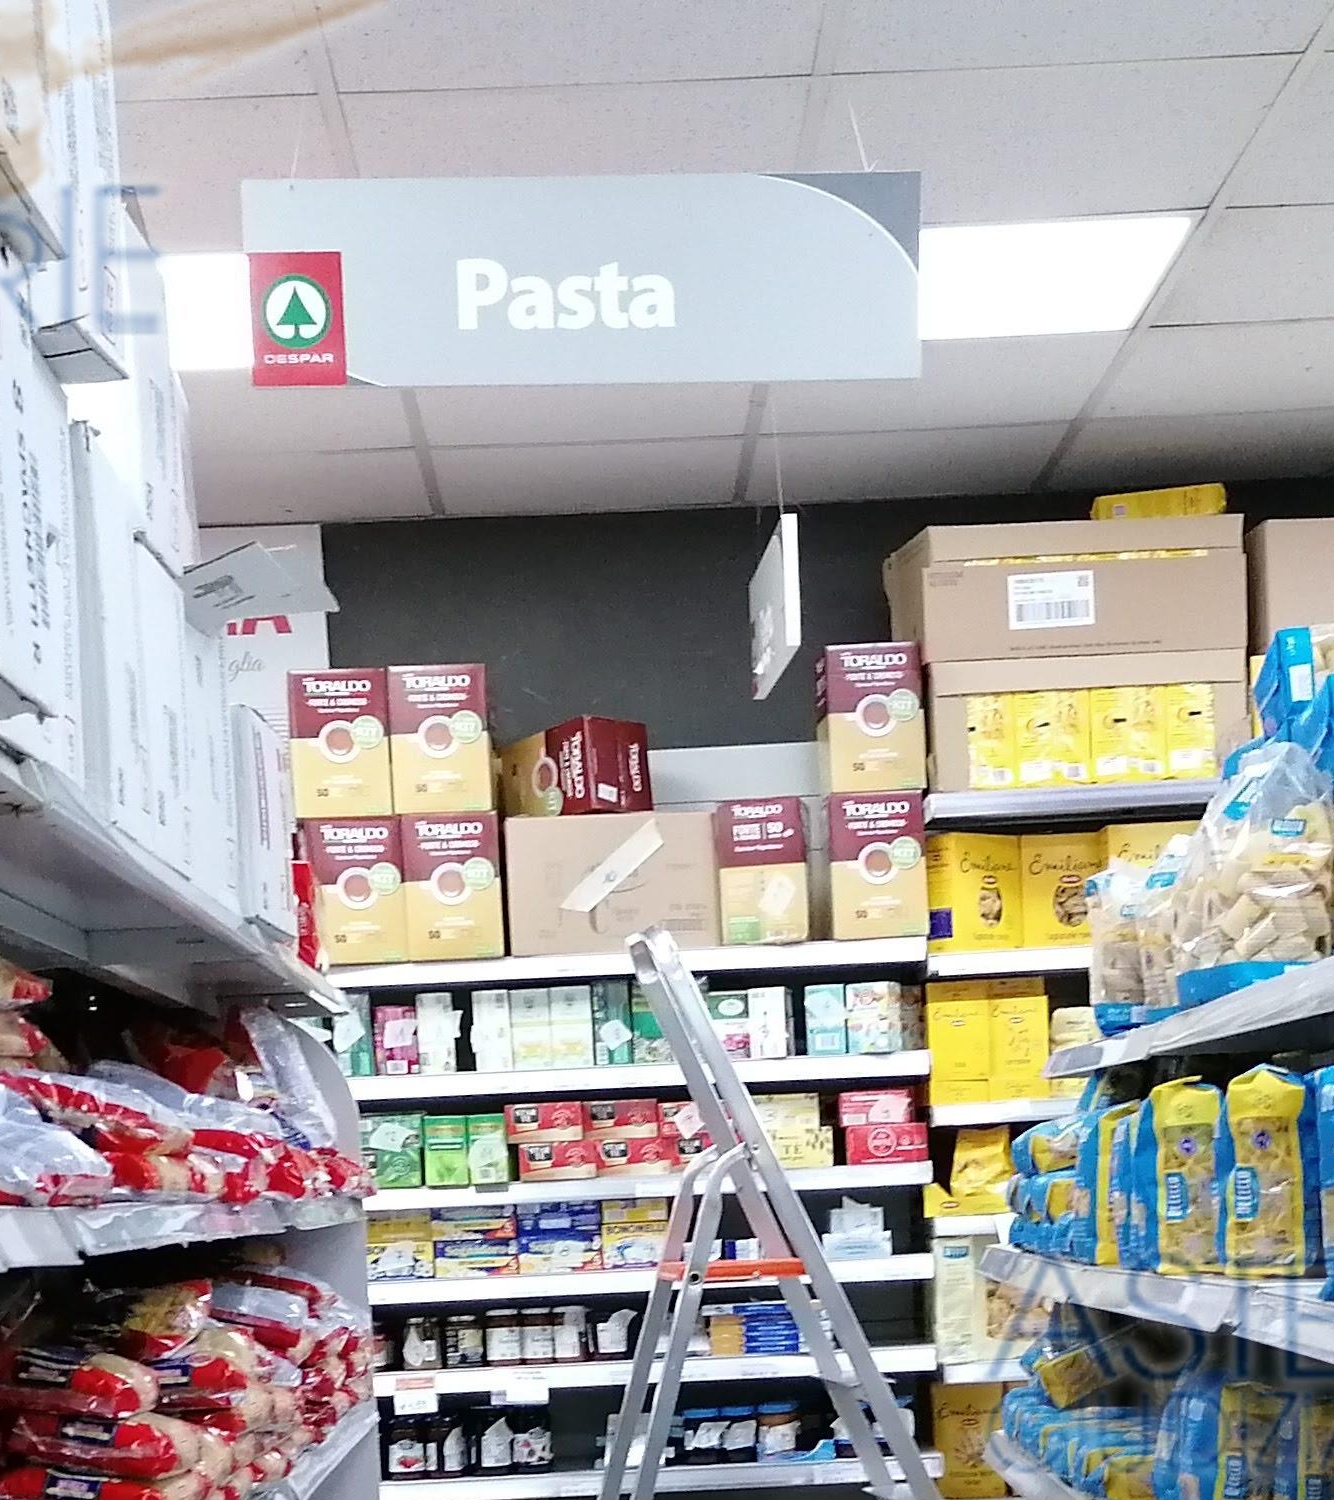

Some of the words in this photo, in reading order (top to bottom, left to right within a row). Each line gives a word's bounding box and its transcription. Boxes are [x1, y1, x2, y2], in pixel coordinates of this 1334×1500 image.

[456, 257, 676, 330] Pasta
[264, 352, 334, 364] DESPAR
[840, 652, 907, 668] TORALDO
[302, 678, 371, 693] TORALDO
[402, 674, 471, 690] TORALDO
[732, 804, 783, 817] TORALDO
[842, 801, 910, 816] TORALDO
[321, 826, 389, 840] TORALDO
[415, 822, 483, 837] TORALDO
